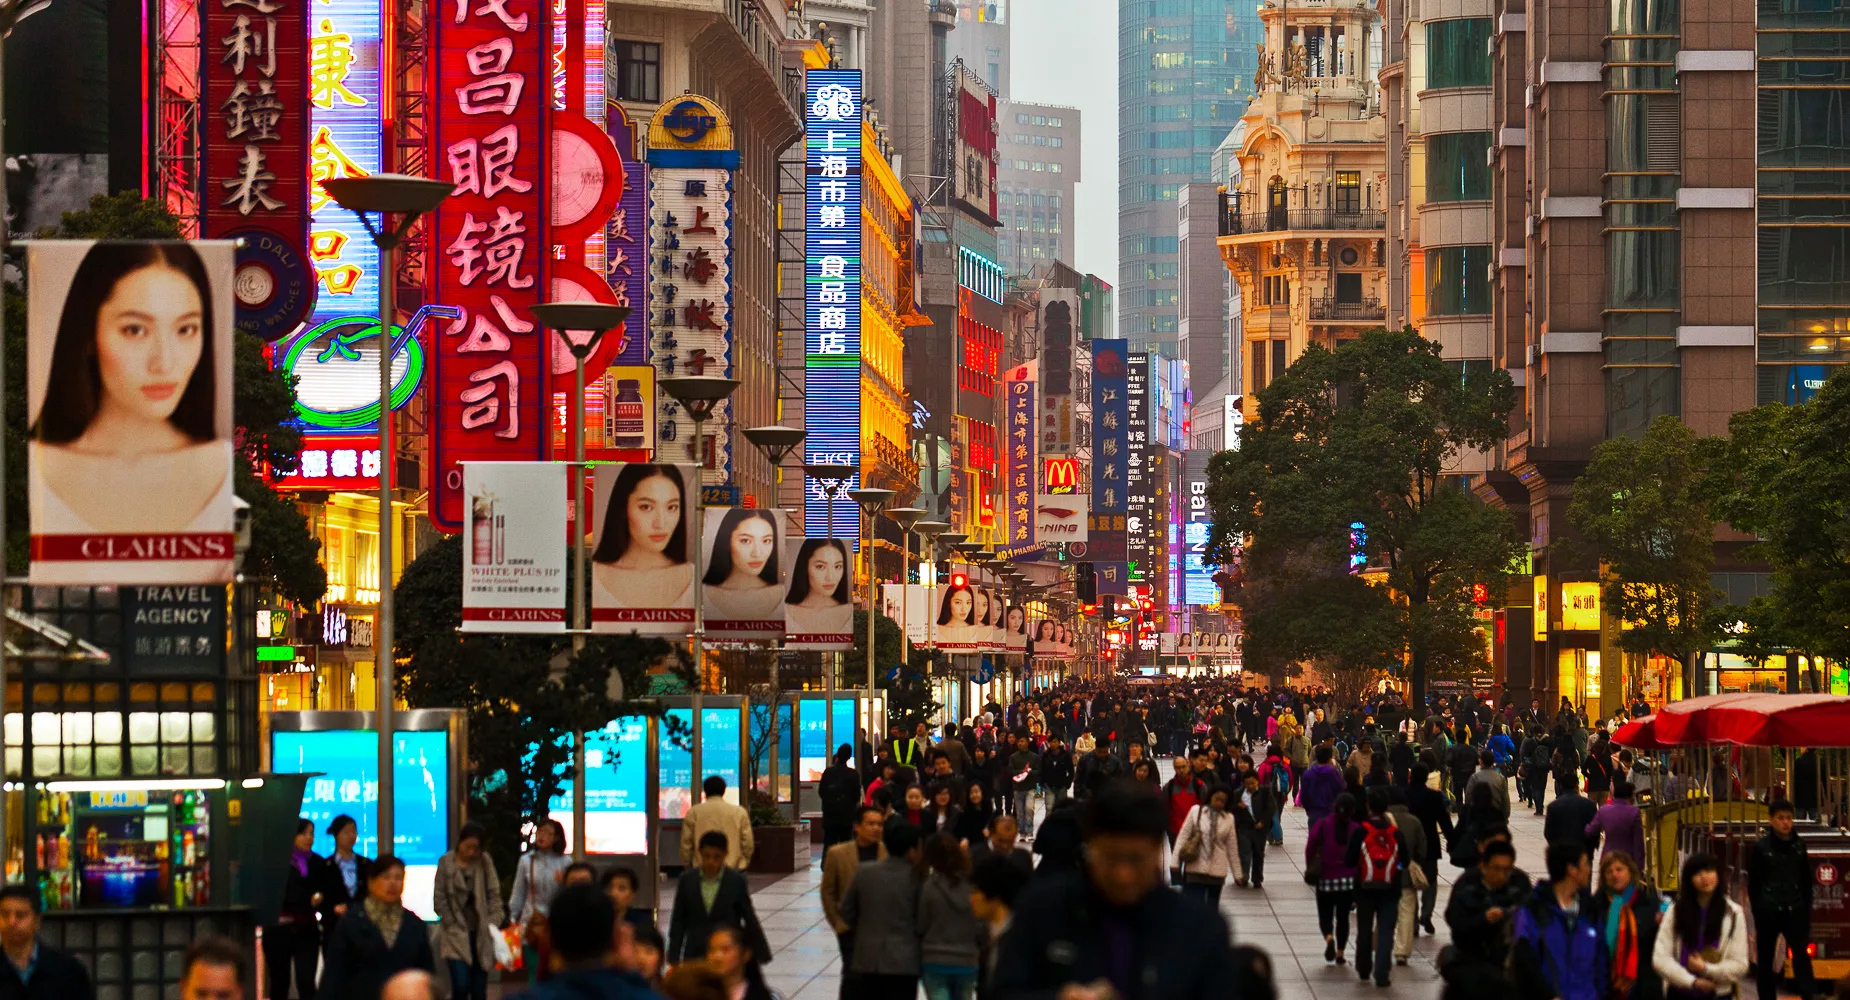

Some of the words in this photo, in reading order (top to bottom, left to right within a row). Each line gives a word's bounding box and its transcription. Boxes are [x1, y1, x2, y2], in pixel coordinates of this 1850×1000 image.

[219, 0, 287, 215] 利鐘表
[818, 129, 849, 355] 上海市第一食品商店
[264, 280, 301, 326] WATCHES
[1013, 397, 1029, 541] 上海市第一医药商店
[81, 536, 226, 559] CLARINS
[997, 548, 1014, 562] NO.1
[1013, 541, 1048, 556] PHARMACY
[471, 567, 510, 577] WHITE
[513, 567, 543, 577] PLUS
[136, 587, 212, 603] TRAVEL
[135, 608, 212, 625] AGENCY
[488, 609, 562, 621] CLARINS
[617, 610, 692, 622] CLARINS
[724, 620, 784, 631] CLARINS
[801, 634, 852, 643] CLARINS
